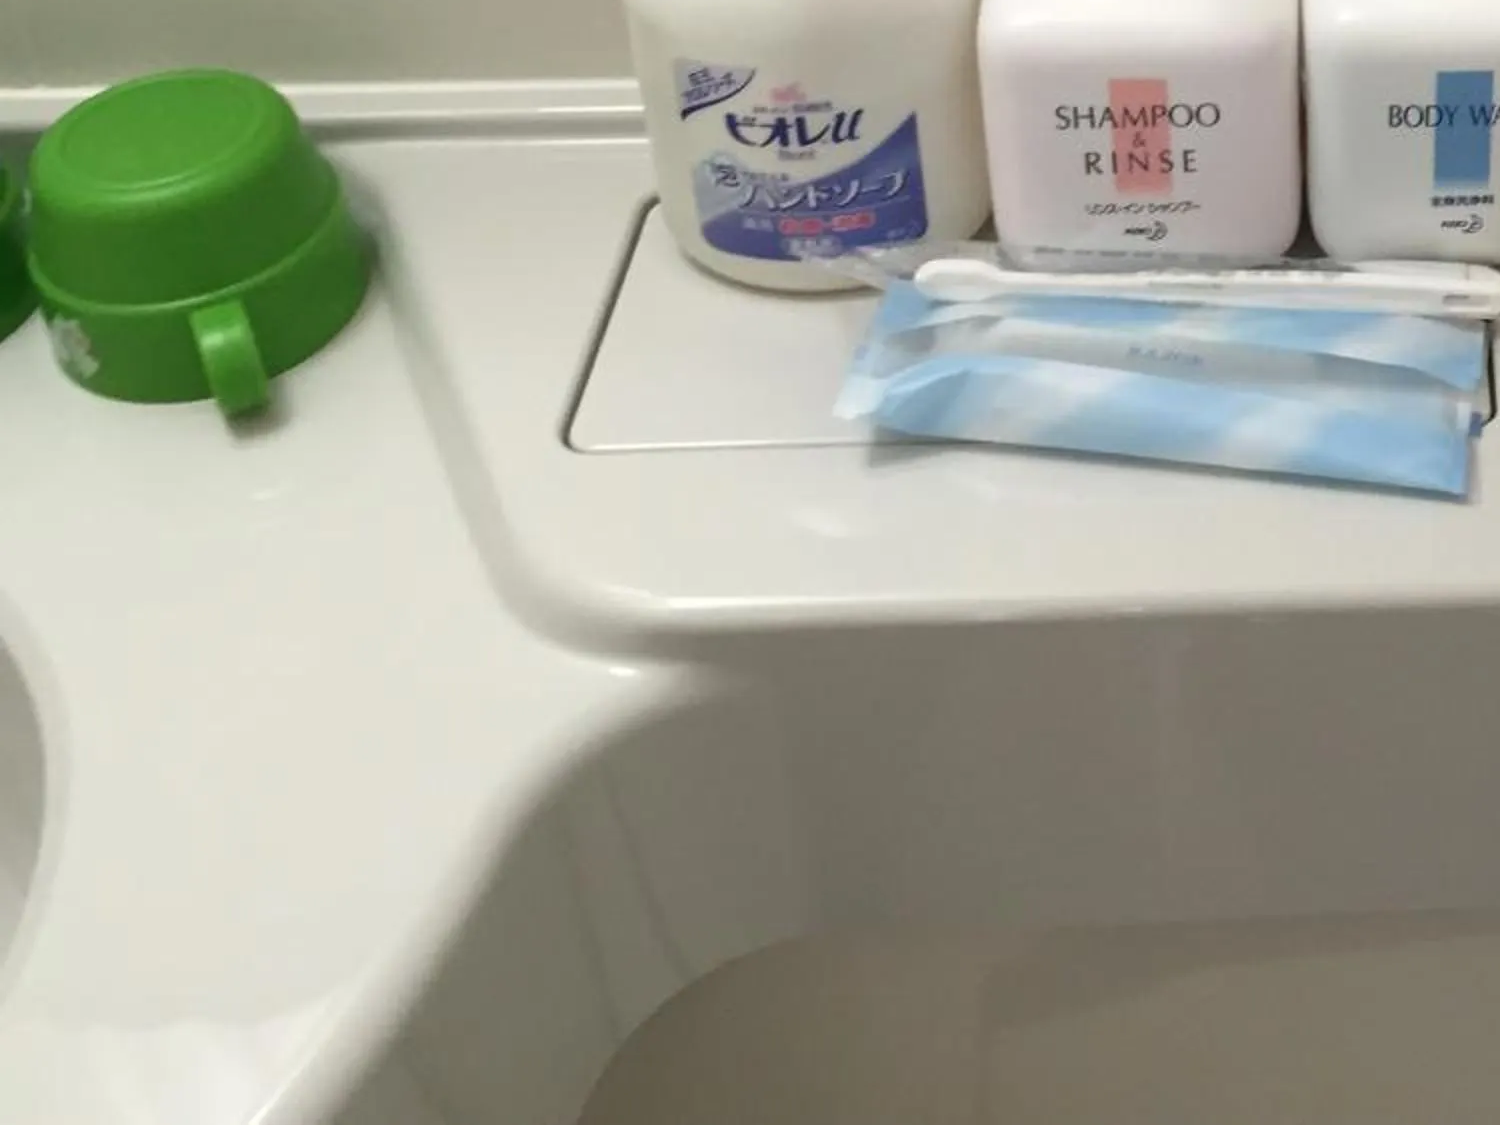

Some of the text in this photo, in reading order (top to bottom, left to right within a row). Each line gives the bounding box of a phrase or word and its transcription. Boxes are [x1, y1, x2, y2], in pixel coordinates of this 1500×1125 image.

[1055, 102, 1221, 130] SHAMPOO
[1388, 104, 1460, 127] BODY
[1132, 131, 1146, 147] &
[1084, 149, 1198, 175] RINSE
